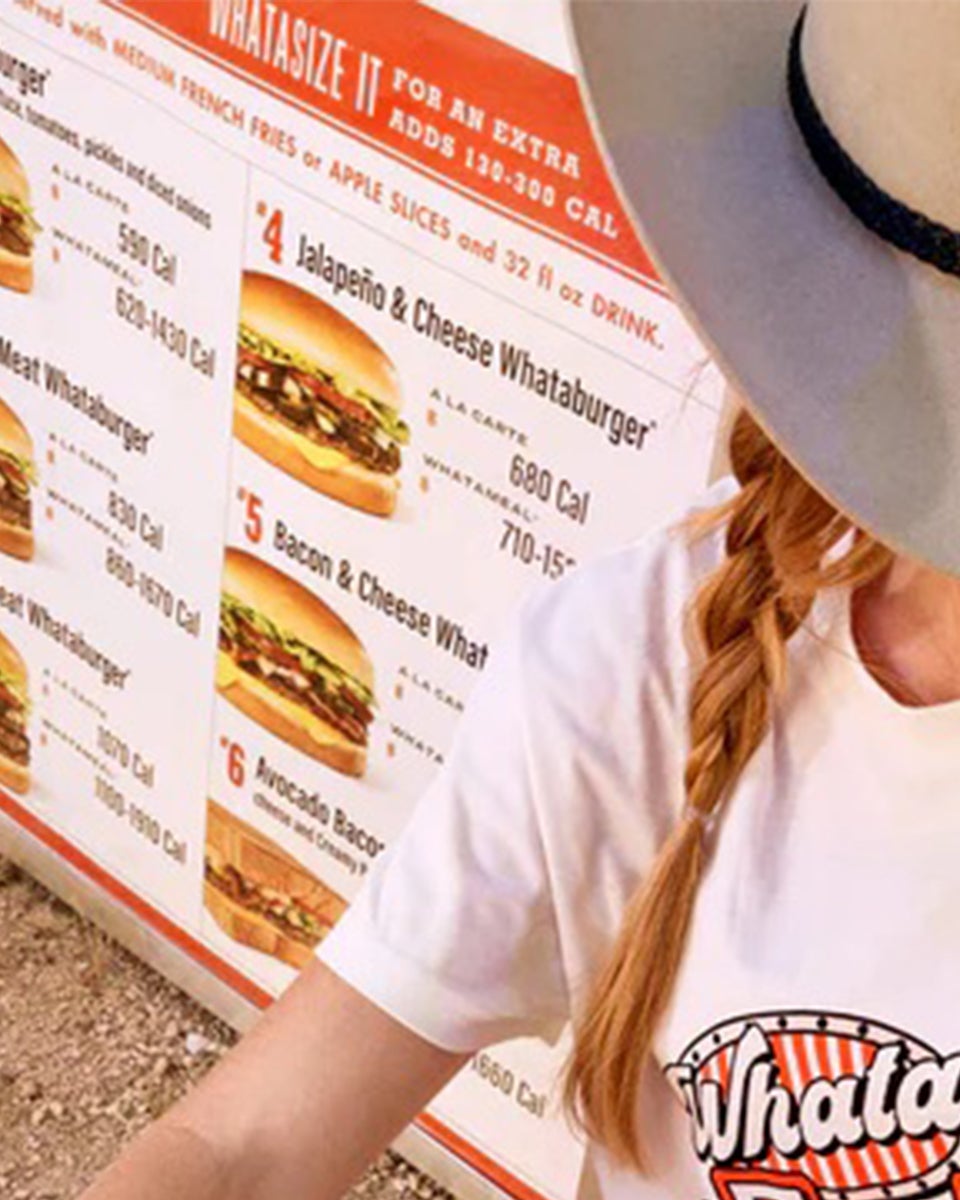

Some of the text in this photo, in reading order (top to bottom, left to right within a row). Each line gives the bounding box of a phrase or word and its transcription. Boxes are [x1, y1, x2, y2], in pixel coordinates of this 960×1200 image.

[209, 0, 383, 118] WHATASIZE IT
[392, 67, 582, 178] FOR AN EXTRA
[112, 38, 176, 88] MEDIUM
[179, 75, 245, 130] FRENCH
[250, 115, 297, 157] FRIES
[329, 158, 383, 204] APPLE
[389, 190, 452, 241] SLICES
[456, 233, 497, 263] and
[502, 248, 532, 281] 32
[591, 291, 665, 351] DRINK.
[388, 107, 455, 159] ADDS
[564, 196, 619, 240] CAL
[152, 243, 177, 287] Cal
[190, 336, 216, 379] Cal
[296, 233, 387, 311] Jalapeño
[388, 285, 408, 325] &
[411, 295, 495, 369] Cheese
[498, 339, 657, 452] Whataburger
[430, 387, 442, 401] A
[509, 452, 592, 525] 680 Cal
[139, 512, 165, 552] Cal
[272, 519, 332, 584] Bacon
[336, 558, 354, 593] &
[357, 569, 432, 639] Cheese
[175, 598, 201, 638] Cal
[131, 751, 155, 790] Cal
[255, 755, 331, 826] Avocado
[163, 828, 188, 866] Cal
[516, 1080, 547, 1119] Cal
